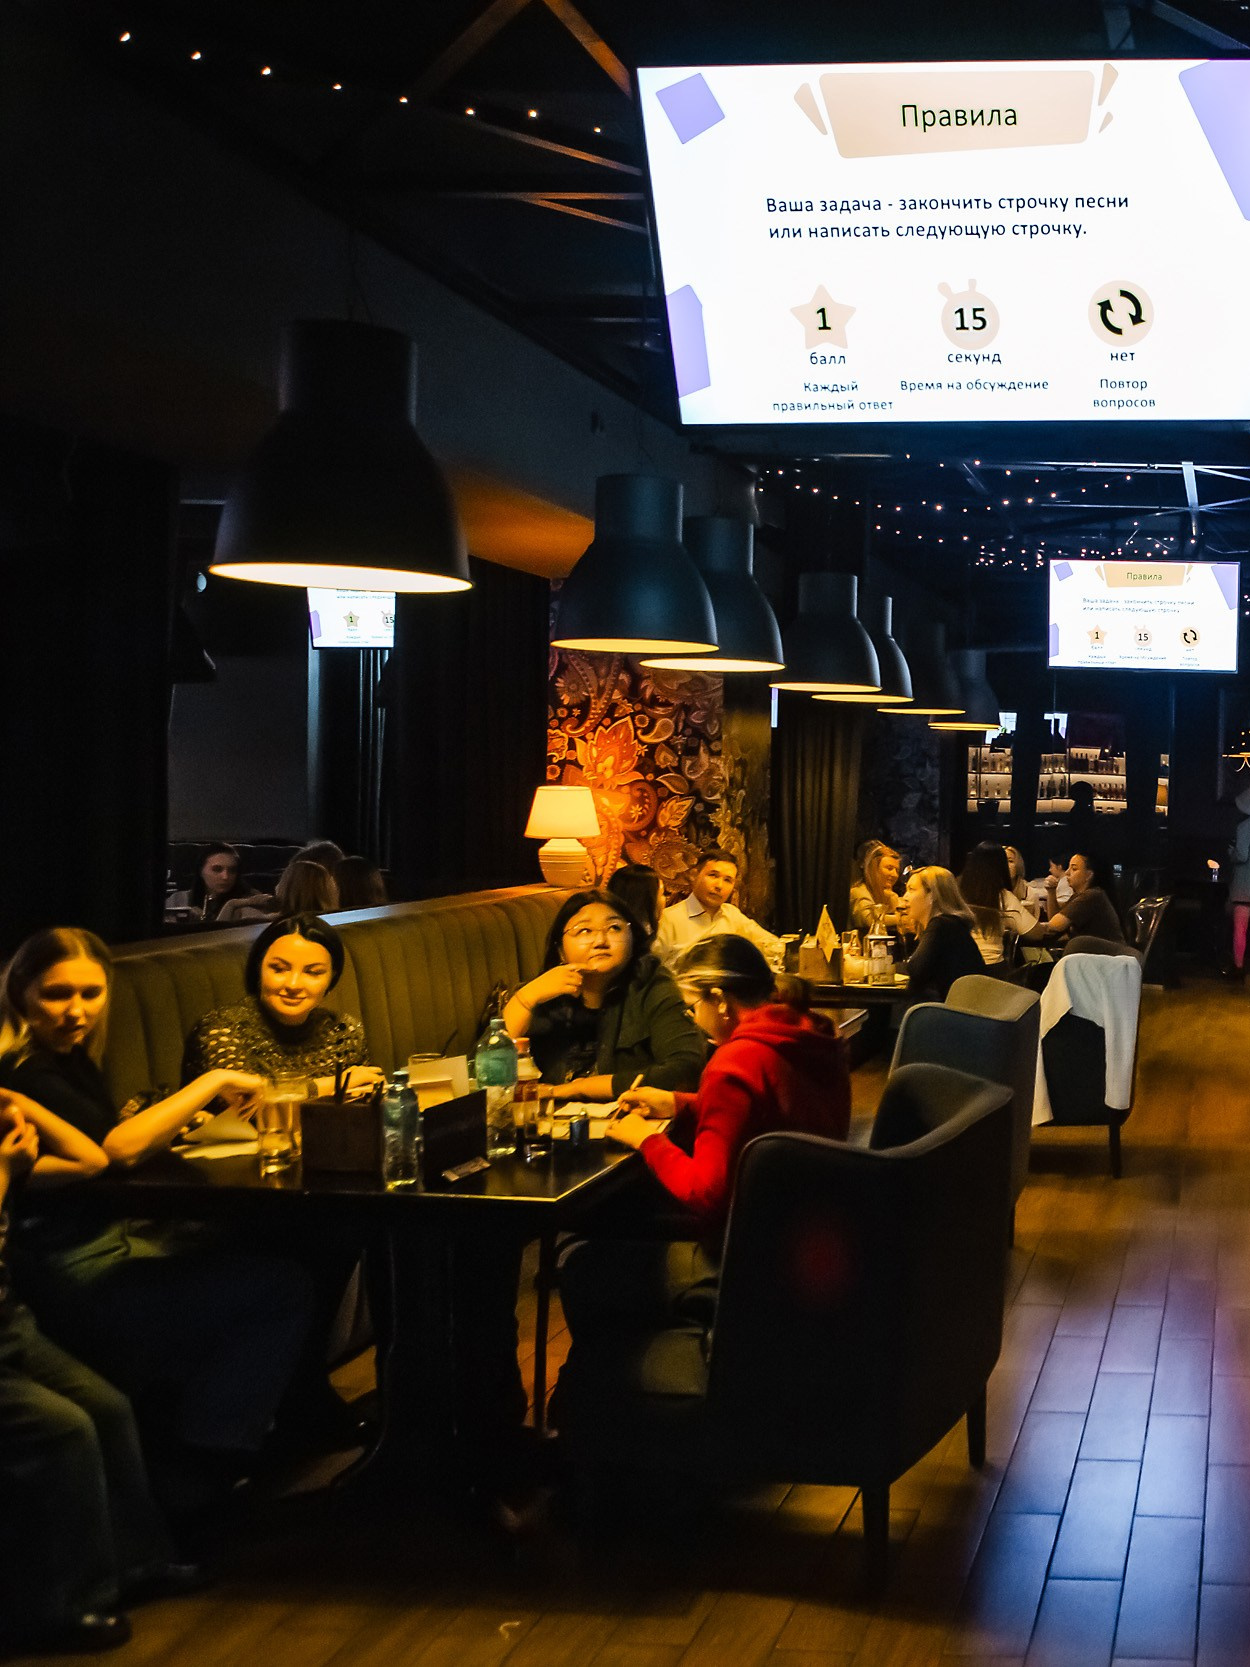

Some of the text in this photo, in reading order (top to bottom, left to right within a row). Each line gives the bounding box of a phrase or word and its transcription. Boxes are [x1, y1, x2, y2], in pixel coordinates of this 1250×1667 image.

[901, 104, 1018, 133] Правила
[766, 197, 814, 213] Ваша
[820, 199, 882, 215] задача
[898, 198, 993, 212] закончить
[998, 197, 1069, 213] строчку
[1074, 196, 1129, 210] песни
[769, 223, 1087, 241] или написать следующую строчку.
[817, 307, 832, 331] 1
[954, 307, 988, 331] 15
[810, 351, 846, 366] балл
[947, 353, 1002, 366] секунд
[1110, 351, 1136, 362] нет
[803, 380, 859, 394] Каждый
[900, 378, 1049, 393] Время на обсуждение
[1099, 378, 1148, 393] Повтор
[772, 399, 893, 414] правильный ответ
[1093, 399, 1156, 411] вопросов
[1126, 572, 1163, 581] Правила
[1094, 631, 1100, 640] 1
[1138, 633, 1149, 642] 15
